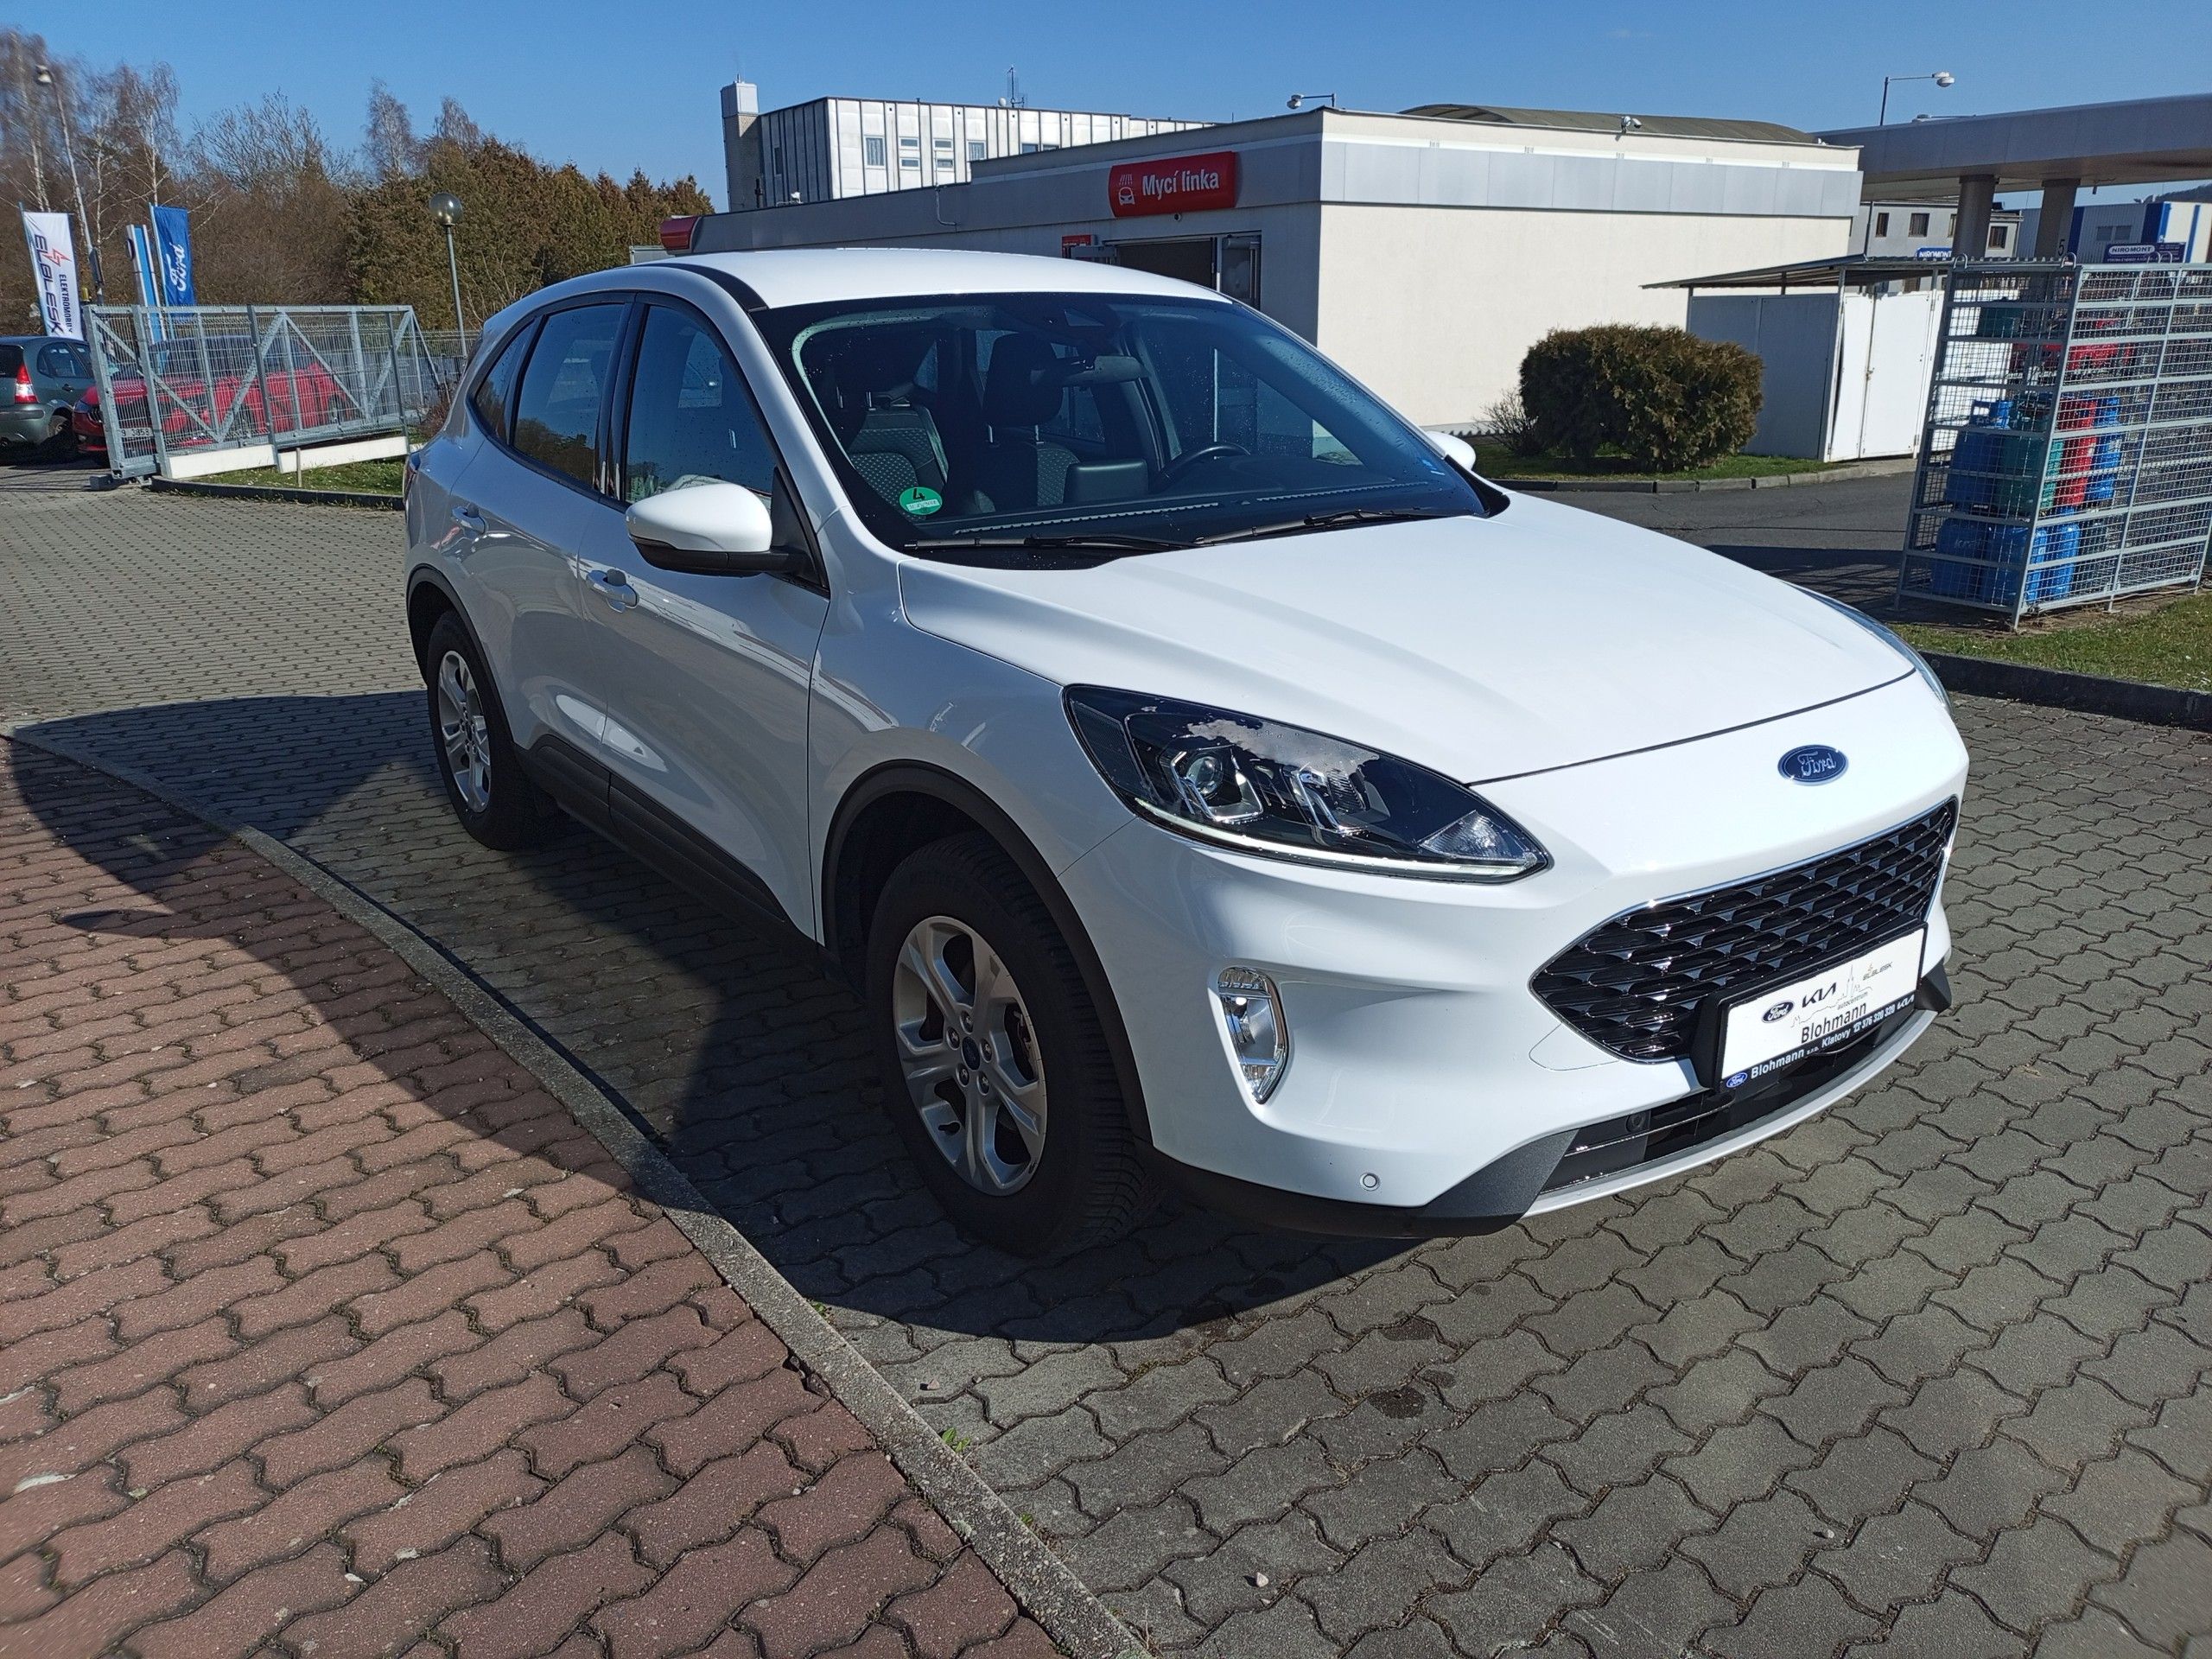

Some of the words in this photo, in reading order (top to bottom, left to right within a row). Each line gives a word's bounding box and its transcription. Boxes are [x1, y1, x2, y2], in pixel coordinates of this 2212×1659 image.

[1142, 170, 1179, 200] Mycí
[1181, 168, 1219, 192] linka
[2058, 238, 2065, 257] 5
[166, 242, 187, 291] Ford
[35, 234, 64, 334] ELBLESK
[913, 487, 926, 500] 4
[1797, 751, 1836, 778] Ford
[1802, 982, 1837, 1008] KIA
[1837, 991, 1868, 1010] autocentrum
[1801, 1003, 1867, 1044] Blohmann
[1751, 1049, 1805, 1079] Blohmann
[1821, 1028, 1852, 1048] Klatovy
